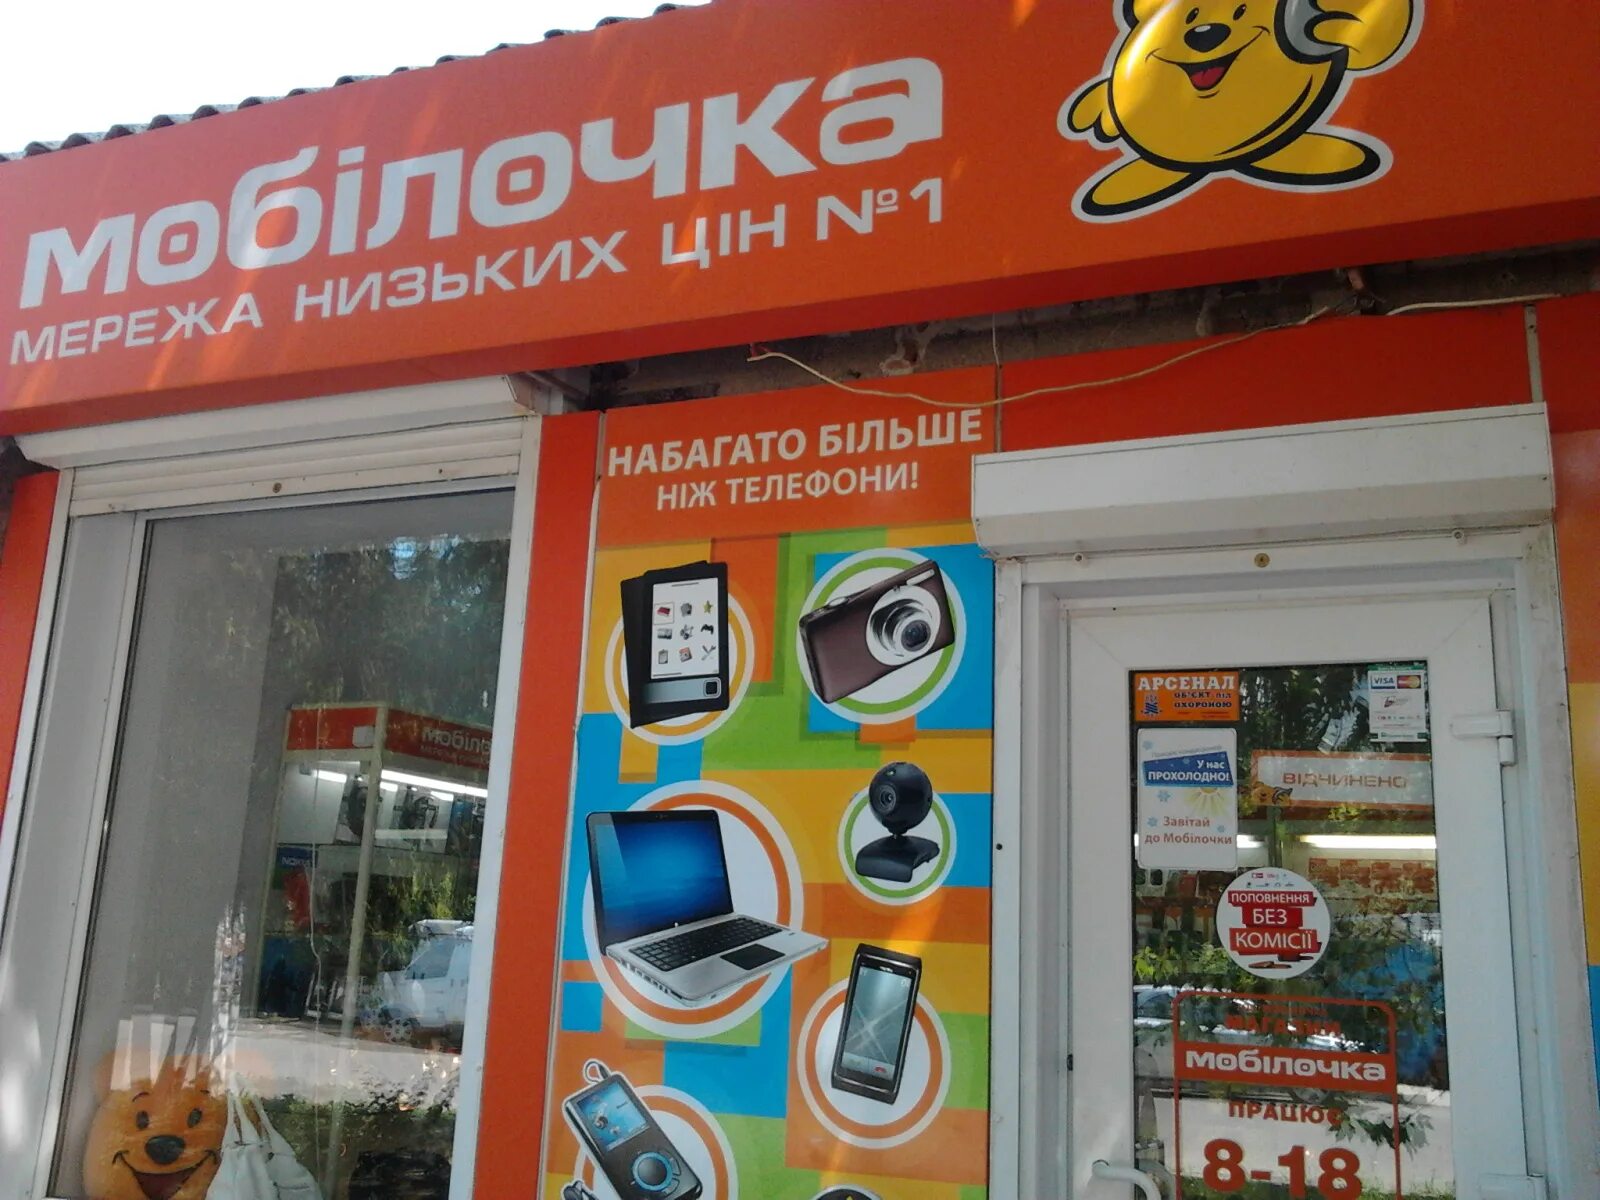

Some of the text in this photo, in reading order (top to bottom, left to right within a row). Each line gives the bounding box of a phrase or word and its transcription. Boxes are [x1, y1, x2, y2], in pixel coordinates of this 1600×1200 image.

[10, 291, 263, 366] МЕРЕЖА
[294, 230, 627, 322] НИЗЬКИХ
[661, 204, 786, 269] ЦІН
[608, 408, 983, 478] НАБАГАТО БІЛЬШЕ
[656, 462, 919, 511] НІЖ ТЕЛЕФОНИ!
[1138, 676, 1235, 691] АРСЕНАЛ
[1197, 760, 1204, 769] У
[1148, 770, 1230, 782] ПРОХОЛОДНО!
[1283, 772, 1407, 788] ВІДЧИНЕНО
[1163, 816, 1211, 827] Завітай
[1145, 832, 1232, 845] до Мобілочки
[1231, 892, 1310, 904] ПОПОВНЕННЯ
[1253, 908, 1288, 925] БЕЗ
[1236, 930, 1312, 949] КОМІСІЇ
[1203, 1138, 1362, 1200] 8-18
